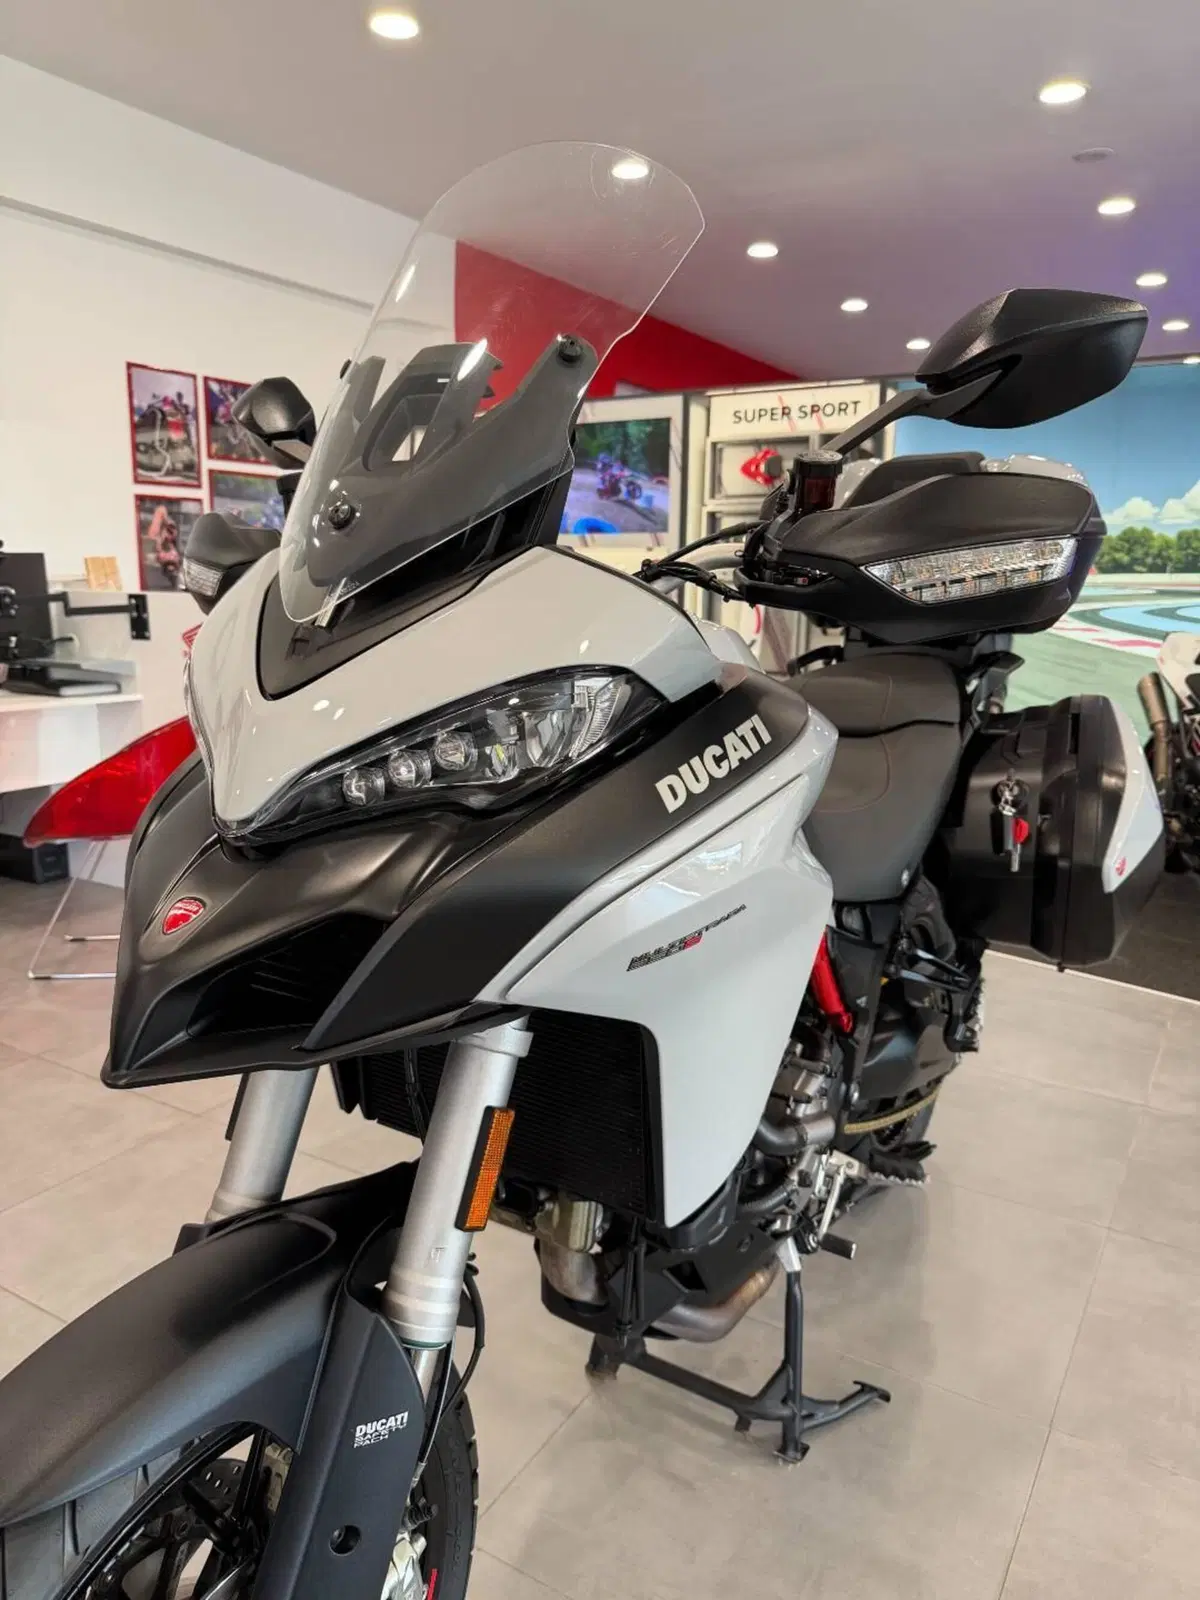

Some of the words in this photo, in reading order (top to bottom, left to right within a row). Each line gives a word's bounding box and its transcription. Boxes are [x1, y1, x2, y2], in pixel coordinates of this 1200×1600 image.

[733, 406, 791, 424] SUPER
[798, 401, 861, 419] SPORT
[655, 714, 772, 813] DUCATI
[355, 1411, 409, 1437] DUCATI
